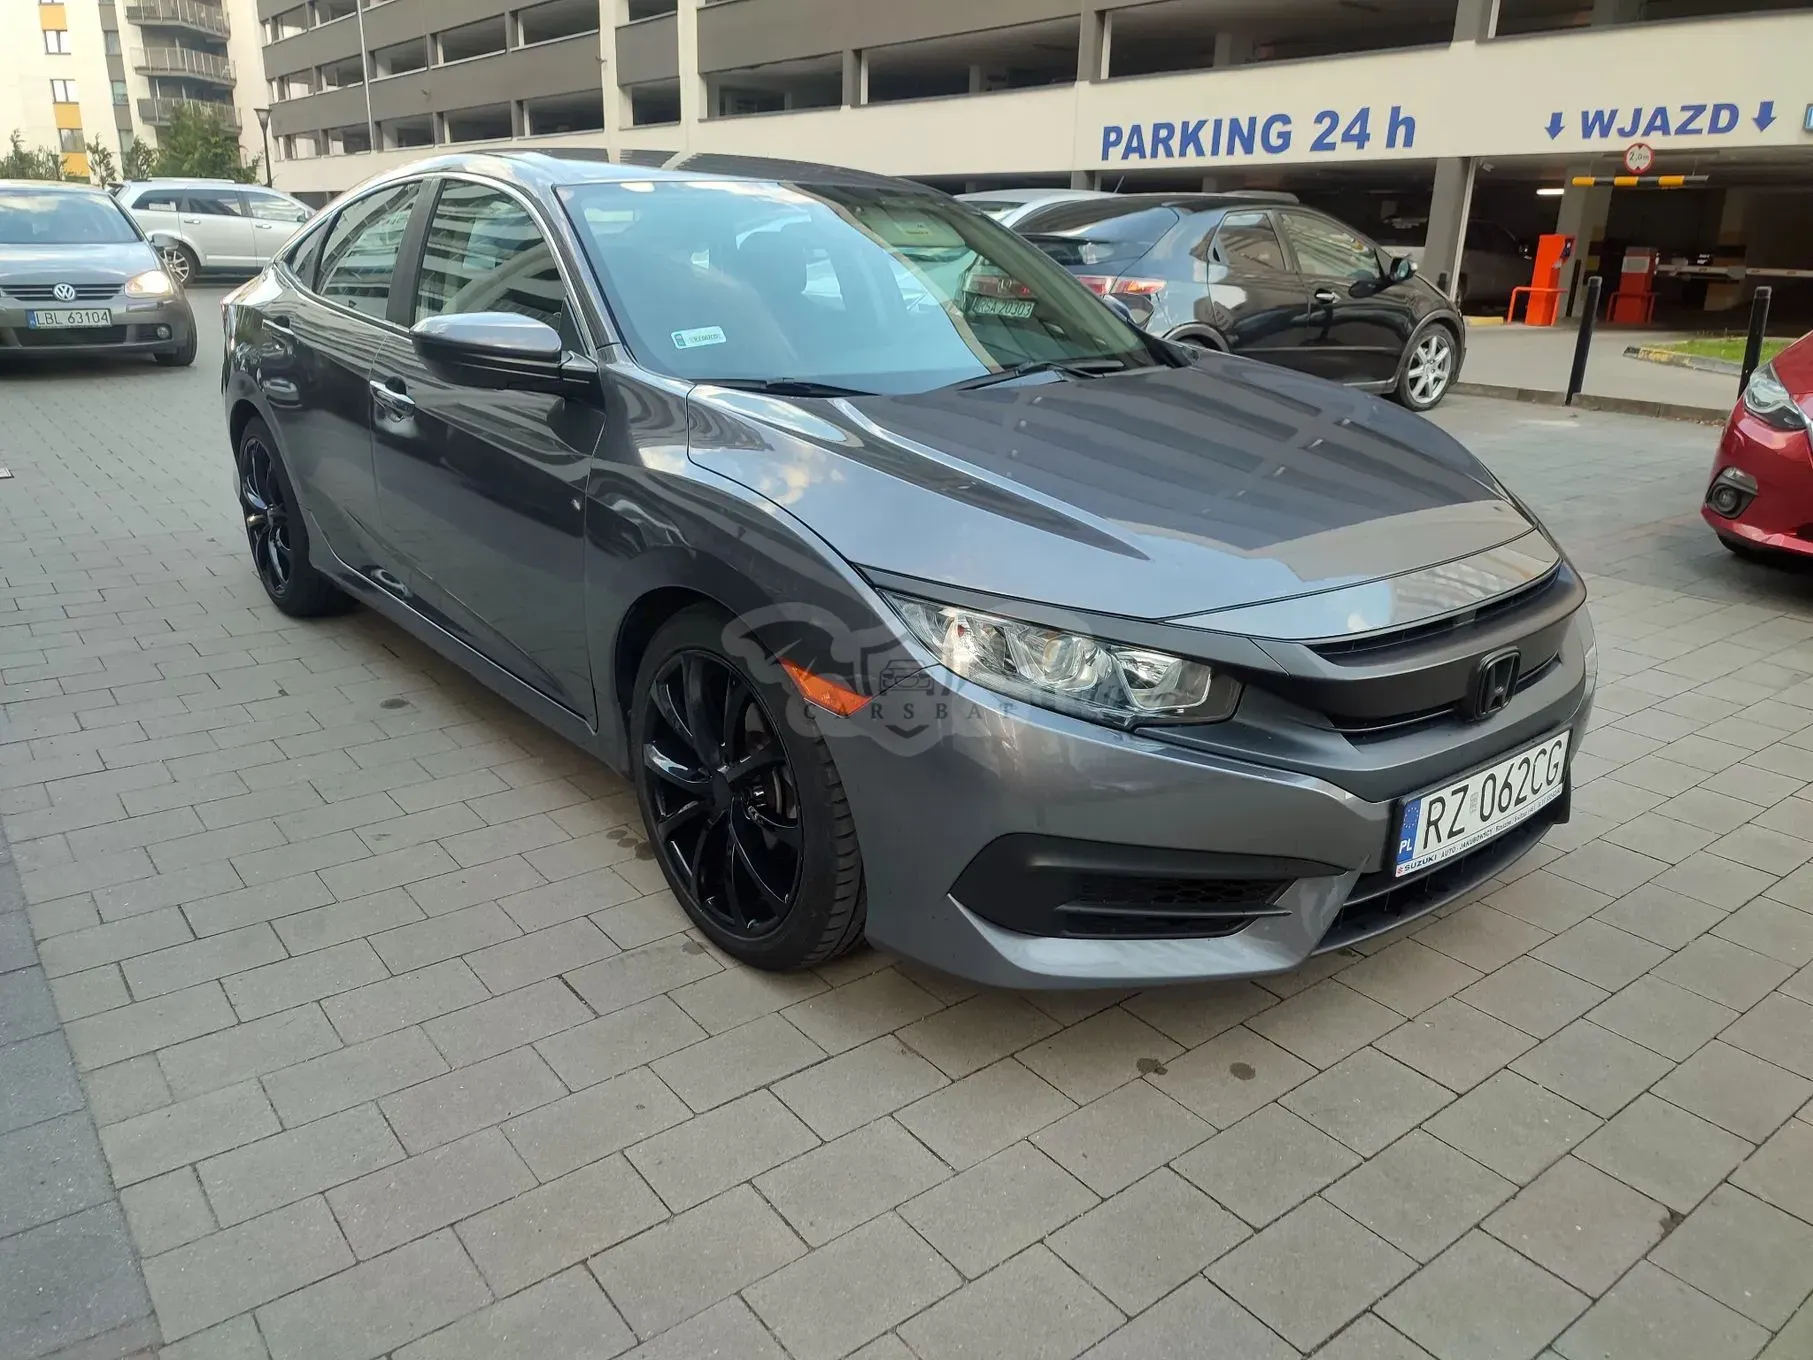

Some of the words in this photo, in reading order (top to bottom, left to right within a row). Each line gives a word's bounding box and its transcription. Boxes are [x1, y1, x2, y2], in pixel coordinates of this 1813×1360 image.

[1101, 113, 1291, 161] PARKING
[1310, 107, 1370, 152] 24
[1386, 105, 1415, 148] h
[1581, 103, 1739, 139] WJAZD
[36, 312, 62, 325] LBL
[67, 311, 109, 324] 63104
[1423, 784, 1470, 849] RZ
[1479, 740, 1562, 823] 062CG
[1399, 838, 1412, 854] PL
[1404, 855, 1437, 871] SUZUKI
